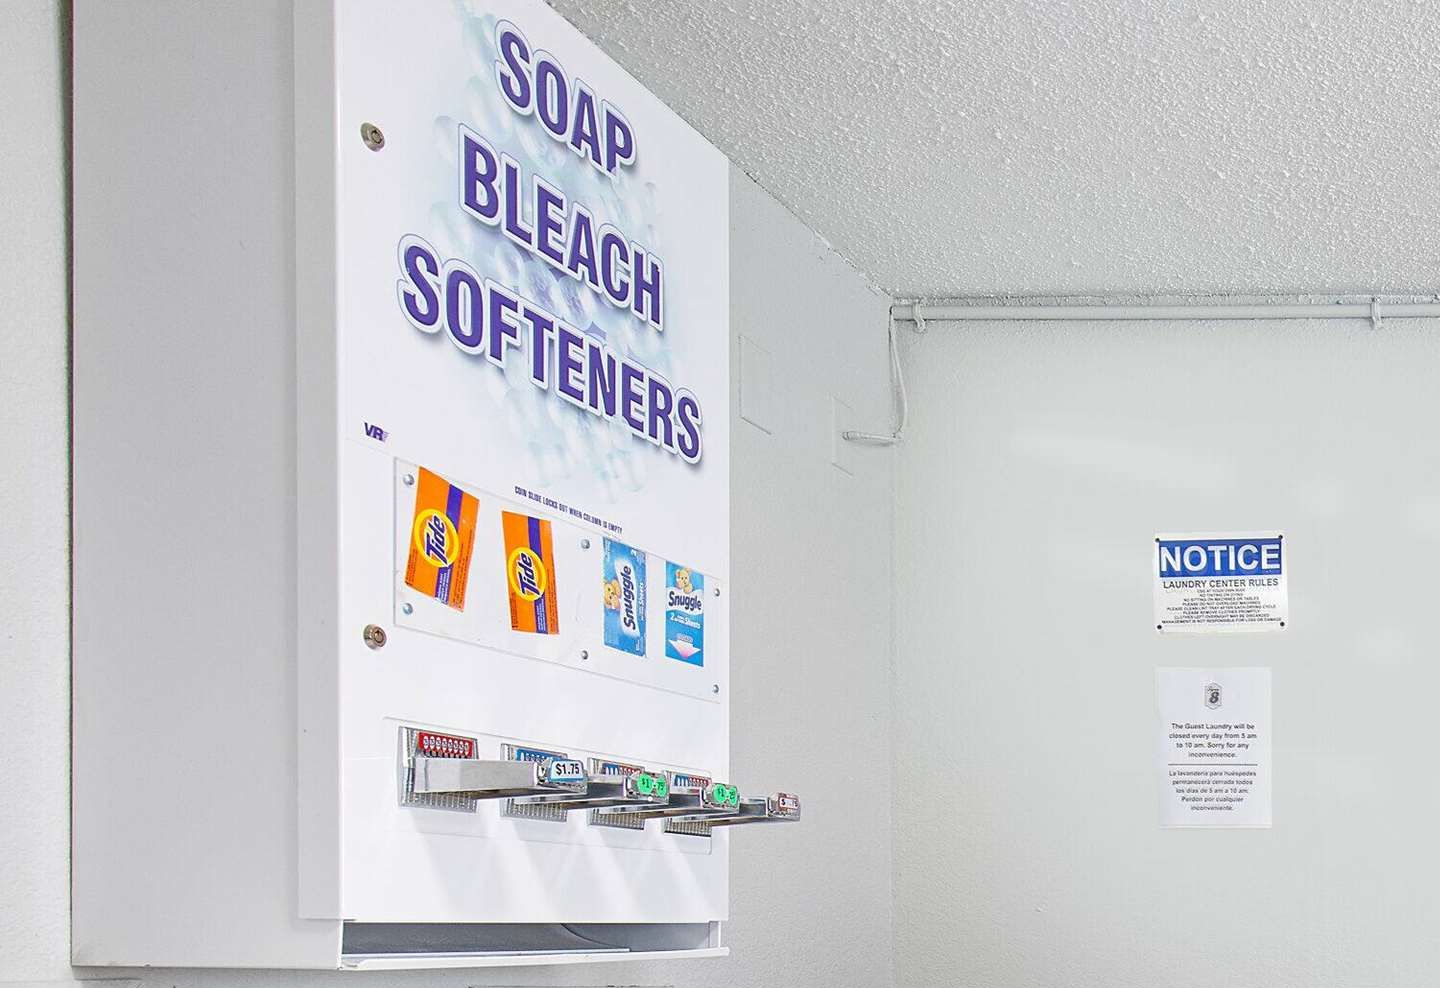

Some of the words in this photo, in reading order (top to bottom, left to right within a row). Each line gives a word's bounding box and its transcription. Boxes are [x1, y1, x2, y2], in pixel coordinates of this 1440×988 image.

[498, 29, 634, 173] SOAP
[463, 133, 662, 326] BLEACH
[402, 244, 701, 461] SOFTENERS
[425, 515, 448, 566] Tide
[1160, 544, 1281, 571] NOTICE
[518, 552, 541, 595] Tide
[1163, 580, 1207, 589] LAUNDRY
[1209, 579, 1246, 588] CENTER
[1248, 578, 1279, 587] RULES
[620, 565, 636, 631] Snuggle
[668, 590, 702, 612] Snuggle
[1206, 723, 1231, 731] Laundry
[556, 762, 580, 775] $1.75
